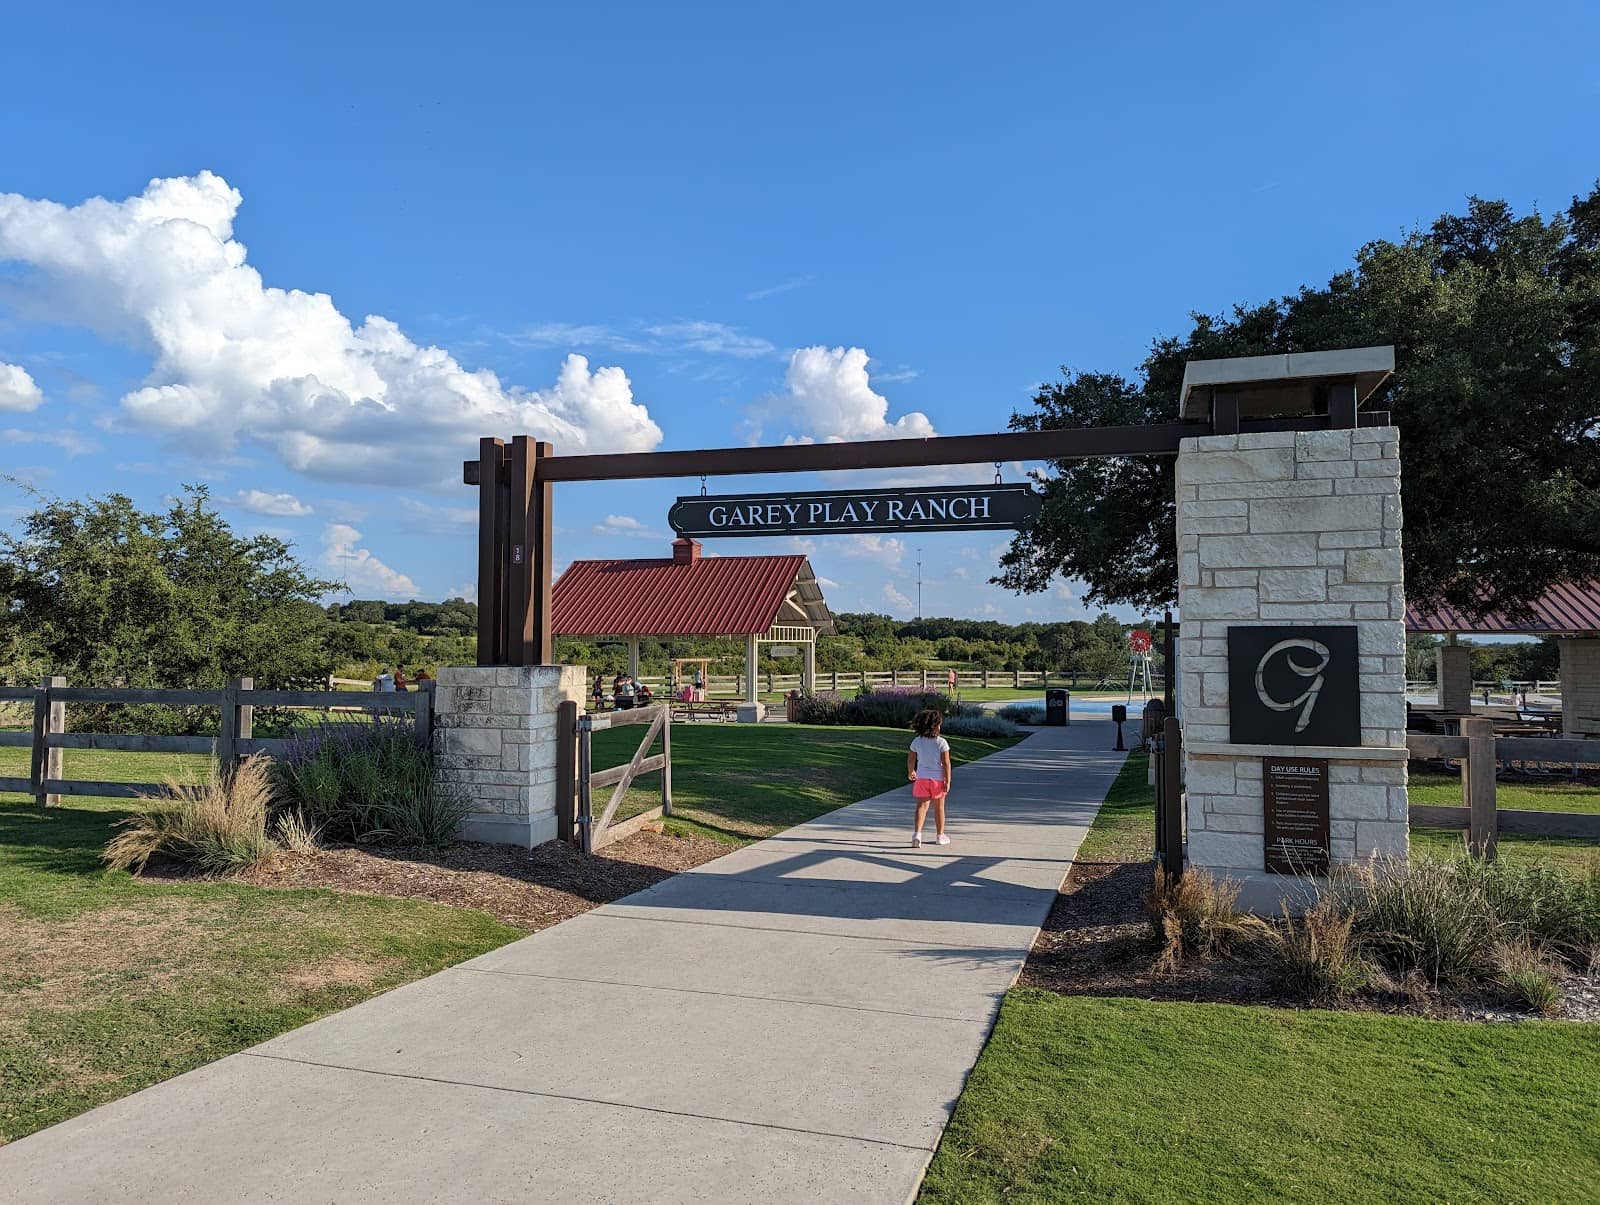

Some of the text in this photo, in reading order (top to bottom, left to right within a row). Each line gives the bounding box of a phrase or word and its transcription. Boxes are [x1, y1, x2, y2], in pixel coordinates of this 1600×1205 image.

[709, 497, 991, 528] GAREY PLAY RANCH
[1300, 766, 1320, 774] RULES
[1276, 836, 1318, 846] PARK HOURS
